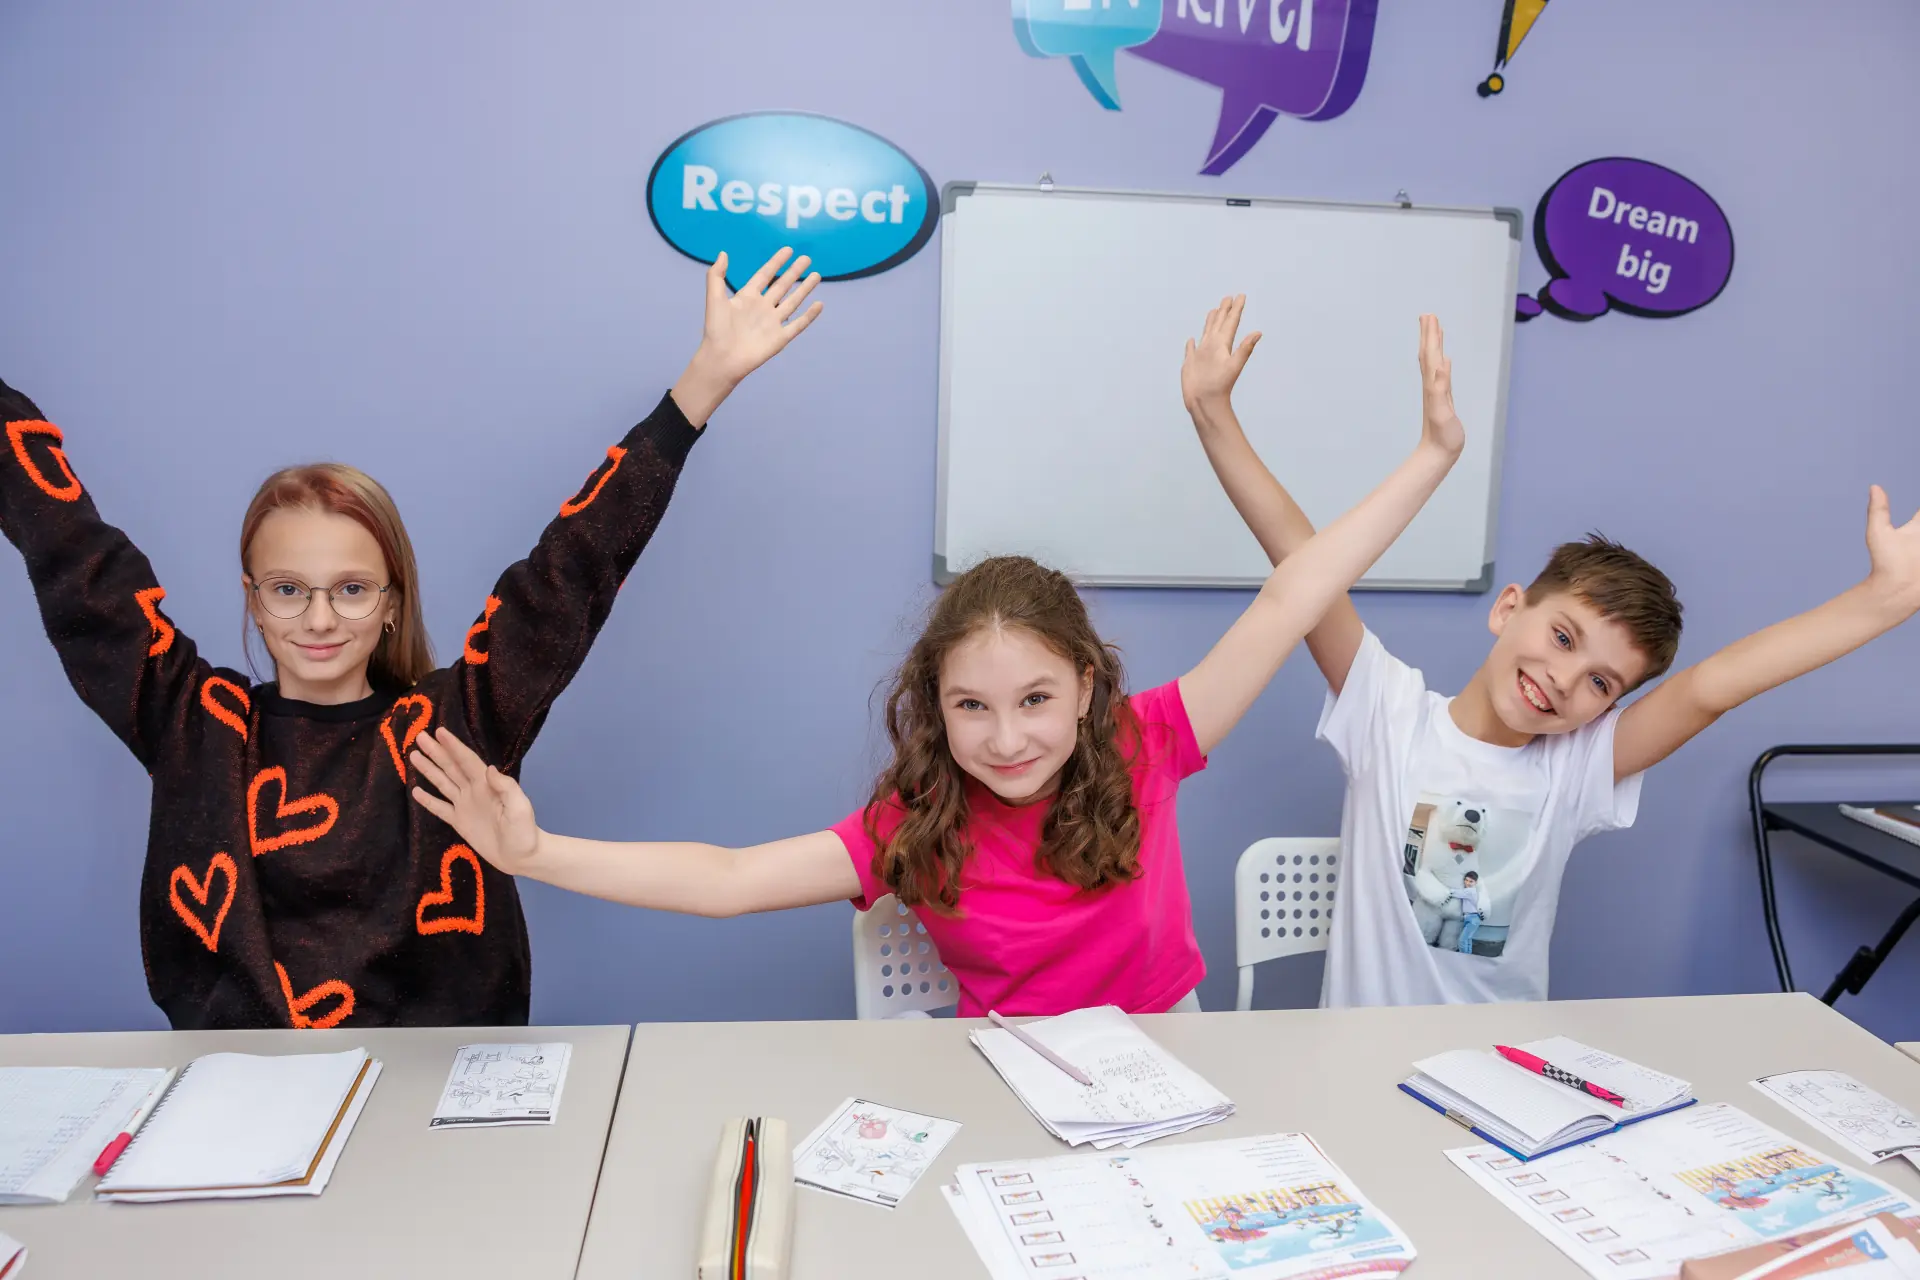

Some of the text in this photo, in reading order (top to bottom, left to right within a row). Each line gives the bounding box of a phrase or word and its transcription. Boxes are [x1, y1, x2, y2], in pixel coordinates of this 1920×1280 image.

[682, 164, 909, 229] Respect
[1587, 186, 1699, 244] Dream
[1616, 244, 1672, 294] big
[1859, 1235, 1878, 1255] 2
